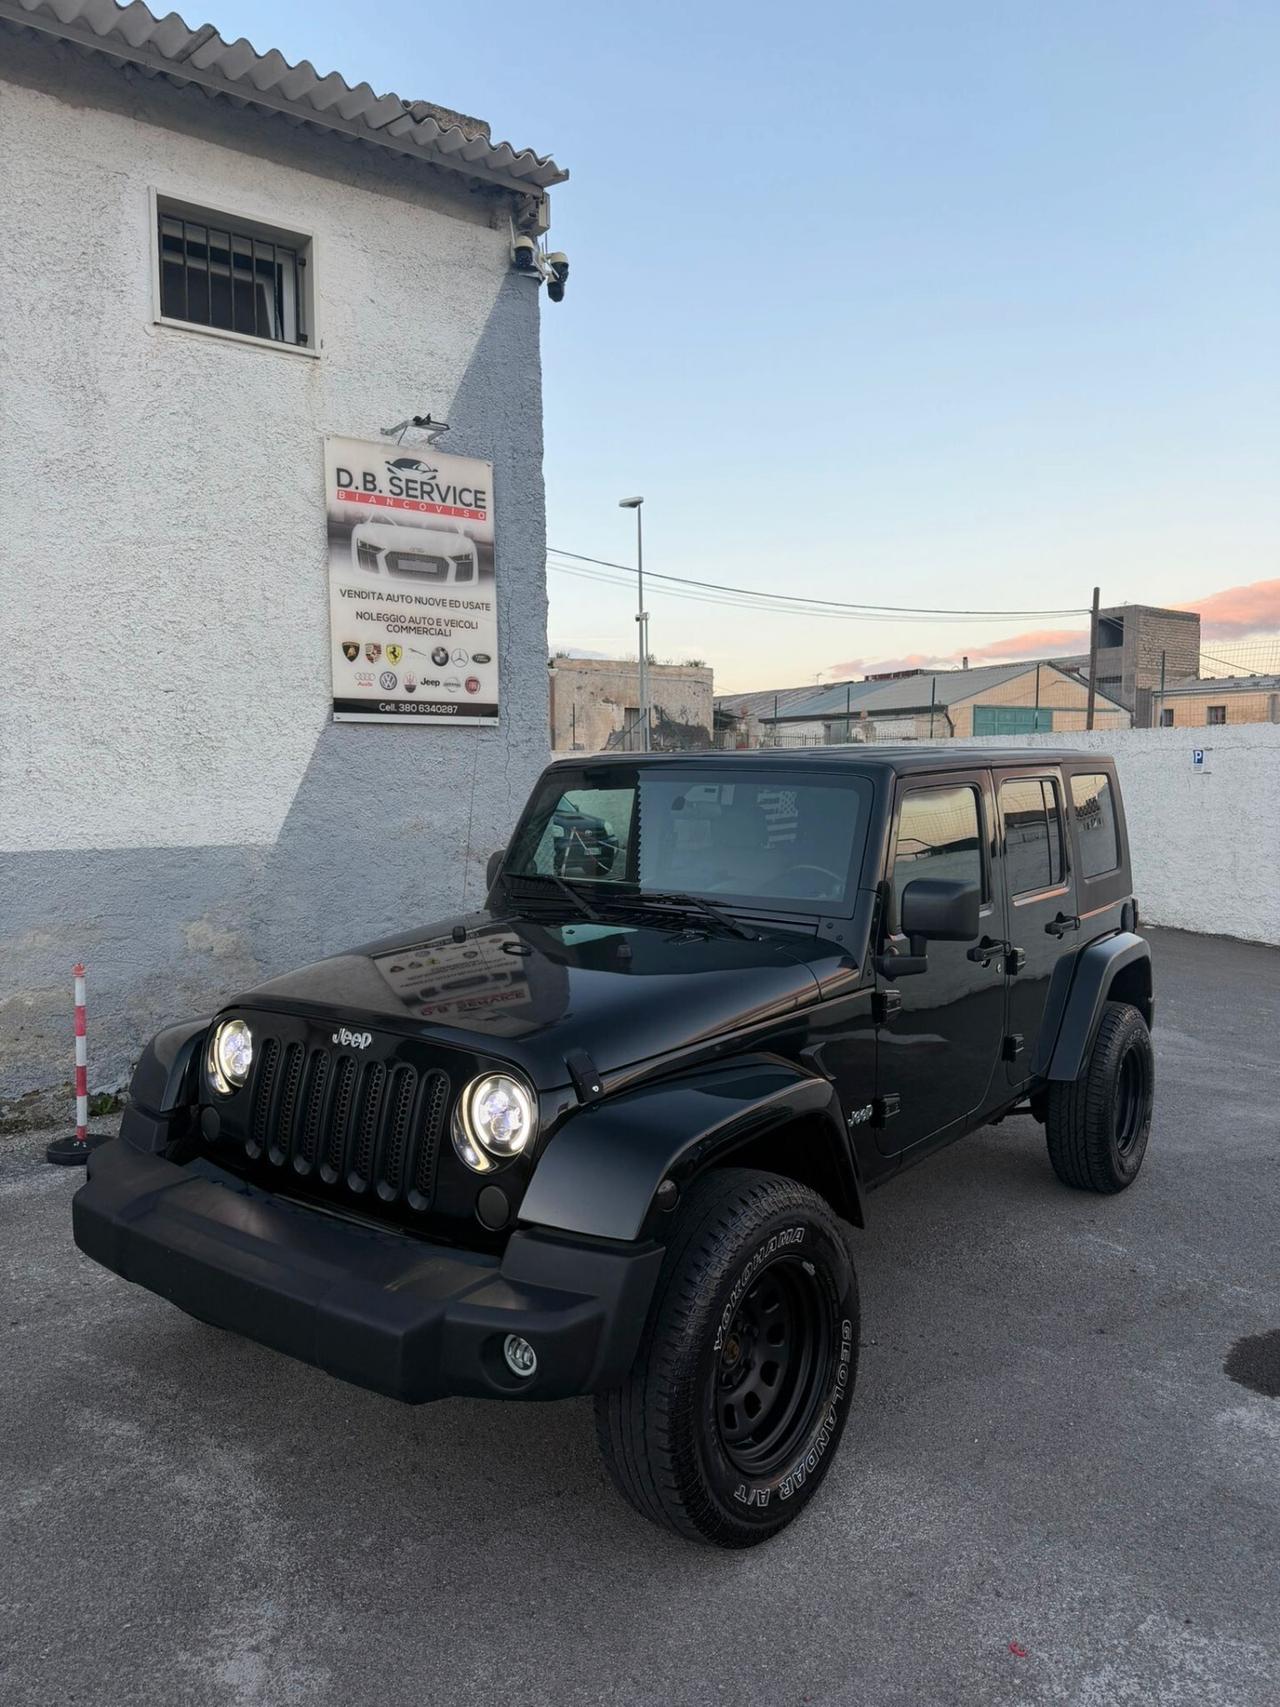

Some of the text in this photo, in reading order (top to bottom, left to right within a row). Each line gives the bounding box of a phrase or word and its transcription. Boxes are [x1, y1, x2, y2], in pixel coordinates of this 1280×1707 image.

[336, 467, 486, 510] D.B. SERVICE
[338, 491, 486, 521] BIANCOVISO
[340, 588, 491, 612] VENDITA AUTO NUOVE ED USATE
[356, 611, 479, 630] NOLEGGIO AUTO E VEICOLI
[386, 624, 452, 637] COMMERCIALI
[420, 677, 441, 688] Jeep
[379, 702, 459, 714] Cell. 380 6340287
[332, 1028, 372, 1050] Jeep
[733, 1319, 852, 1507] GEOLANDAR A/T
